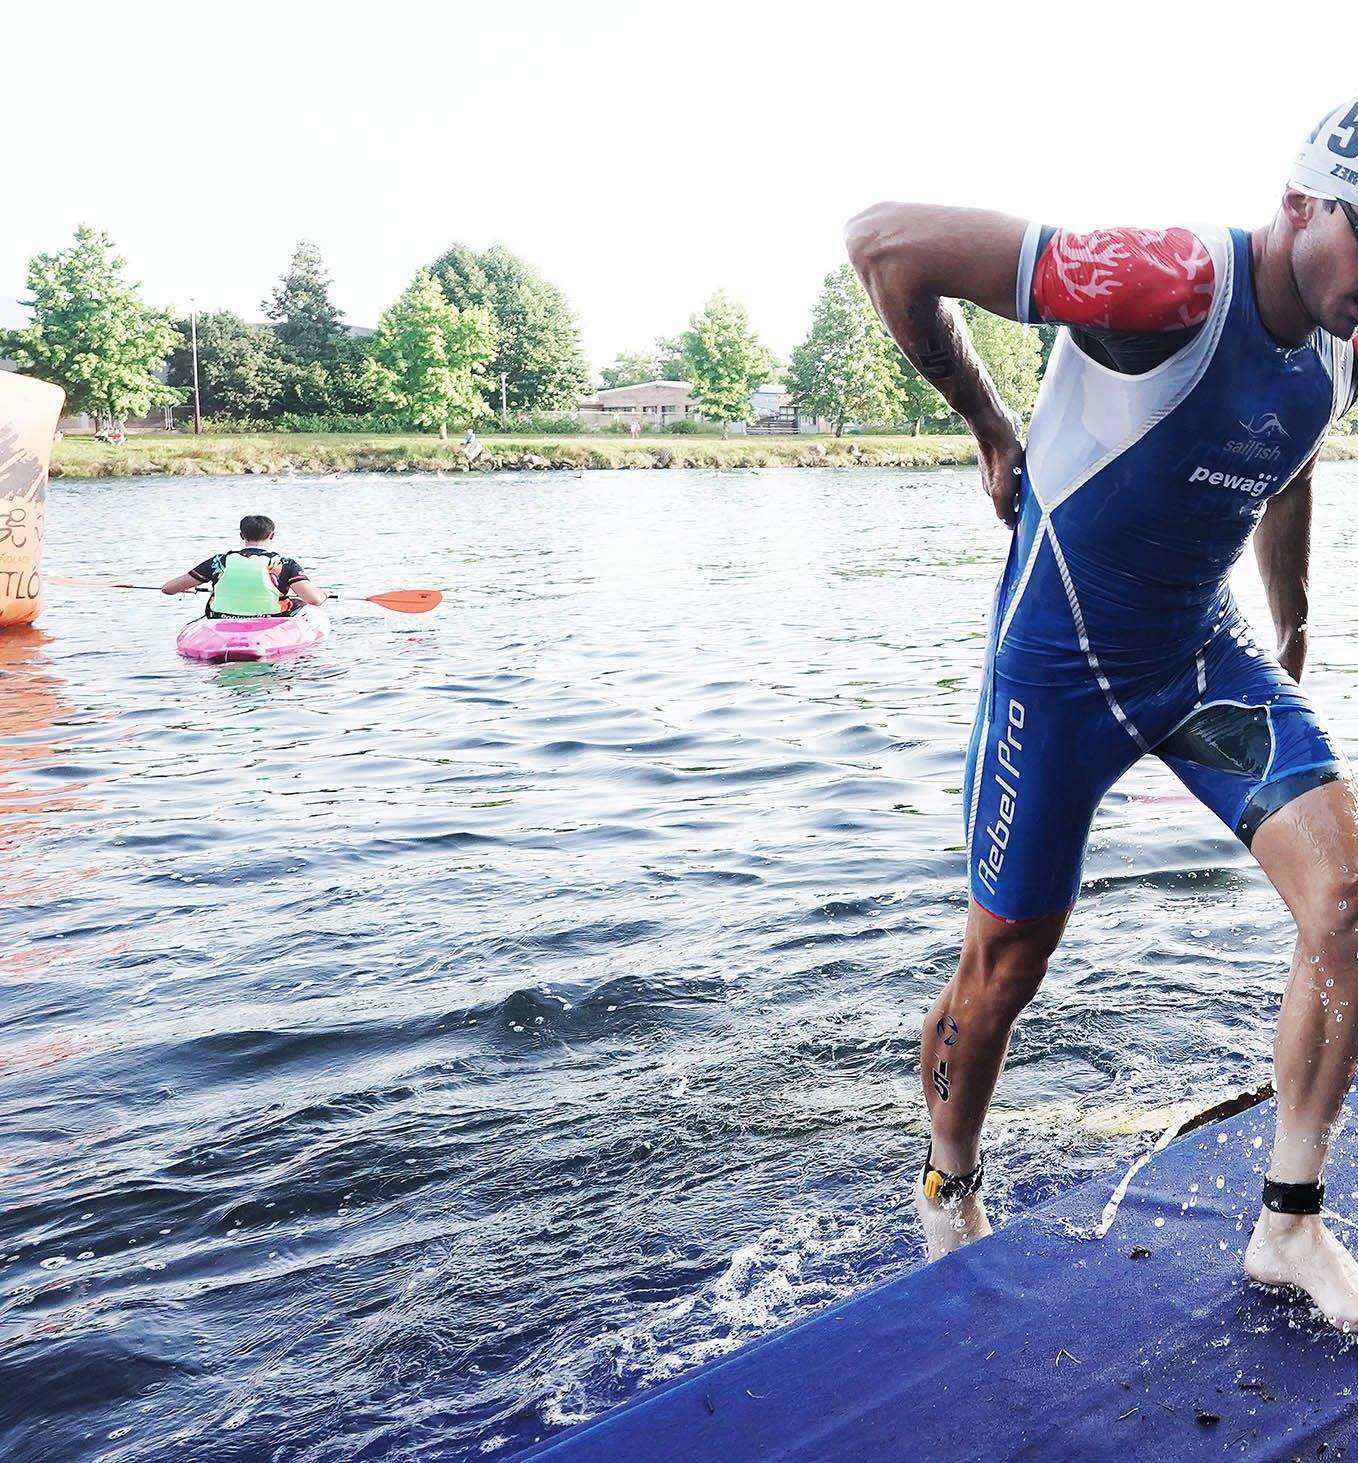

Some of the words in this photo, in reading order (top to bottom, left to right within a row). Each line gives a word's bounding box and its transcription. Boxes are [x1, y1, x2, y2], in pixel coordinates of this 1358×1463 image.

[1223, 440, 1282, 462] sailfish
[1188, 466, 1269, 498] pewag
[997, 698, 1026, 779] Pro
[978, 774, 1017, 896] Rebel
